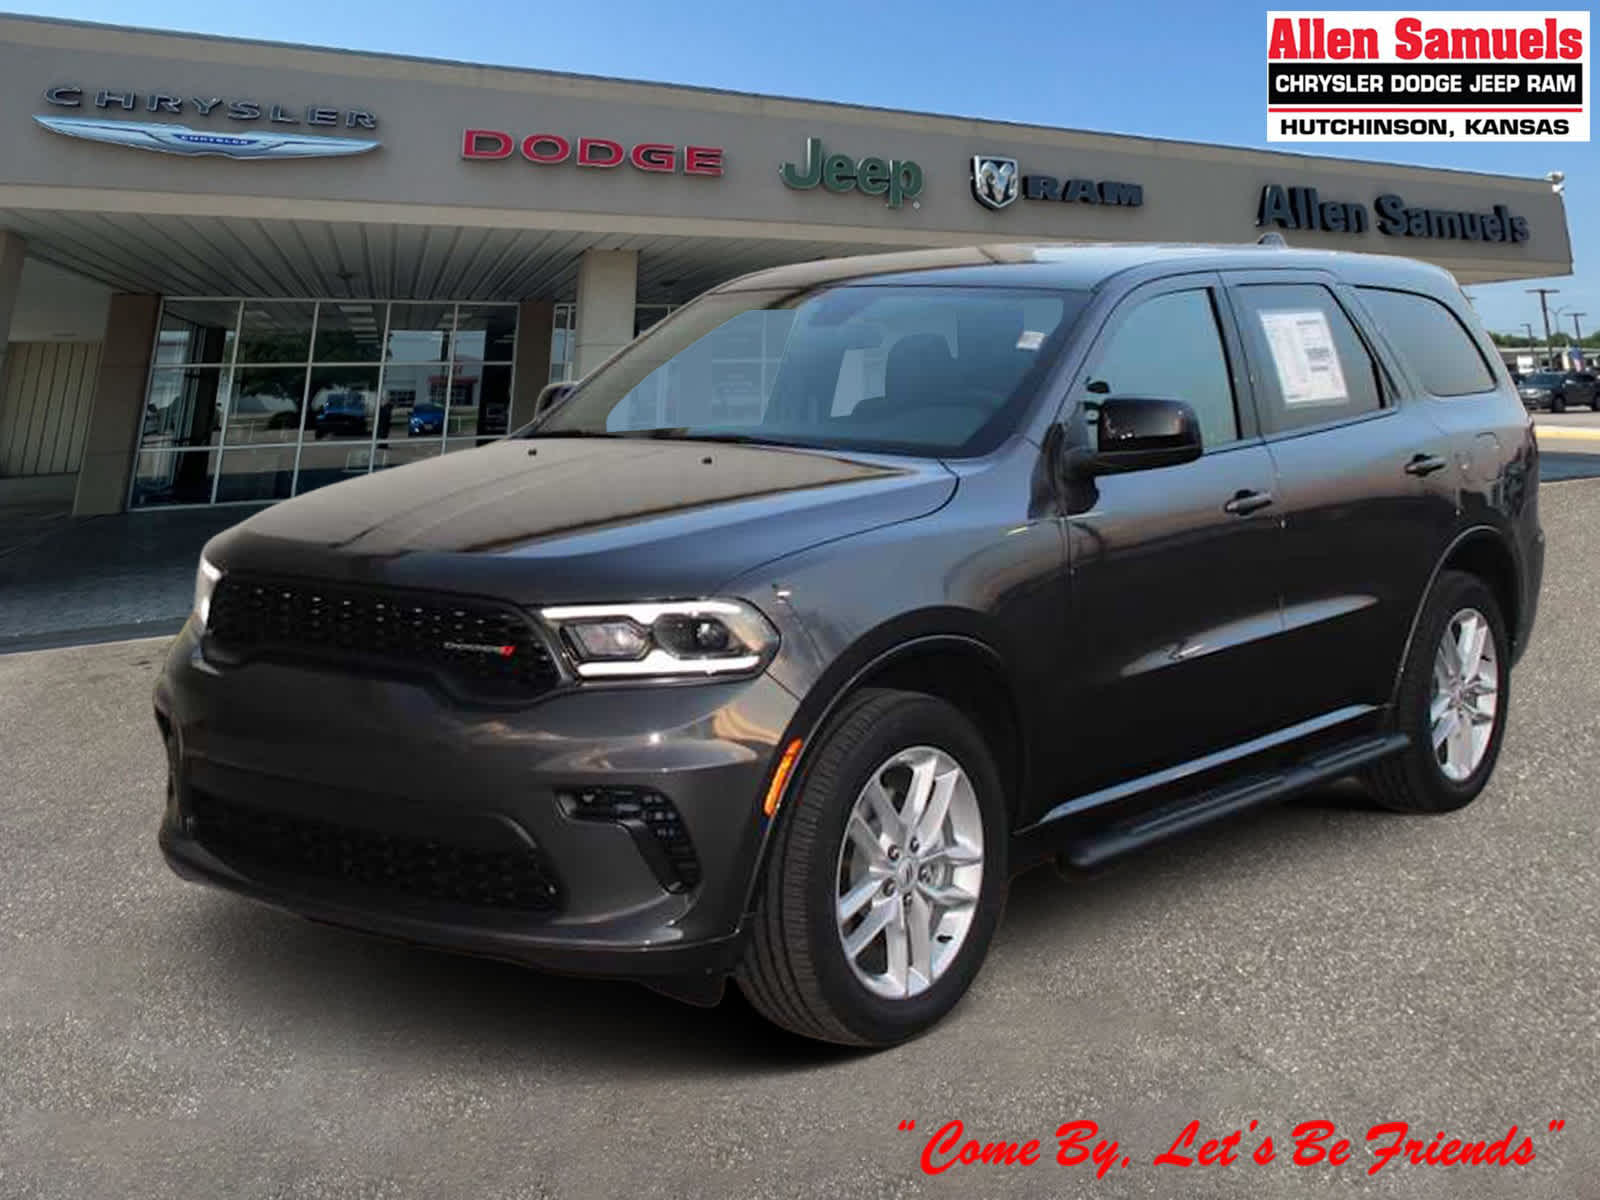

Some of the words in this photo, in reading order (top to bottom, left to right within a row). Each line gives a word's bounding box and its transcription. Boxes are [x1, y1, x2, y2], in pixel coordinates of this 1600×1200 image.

[44, 86, 378, 129] CHRYSLER
[461, 127, 725, 177] DODGE
[779, 137, 924, 208] Jeep
[1023, 175, 1144, 207] RAM
[1256, 184, 1368, 233] Allen
[1375, 194, 1530, 243] Samuels
